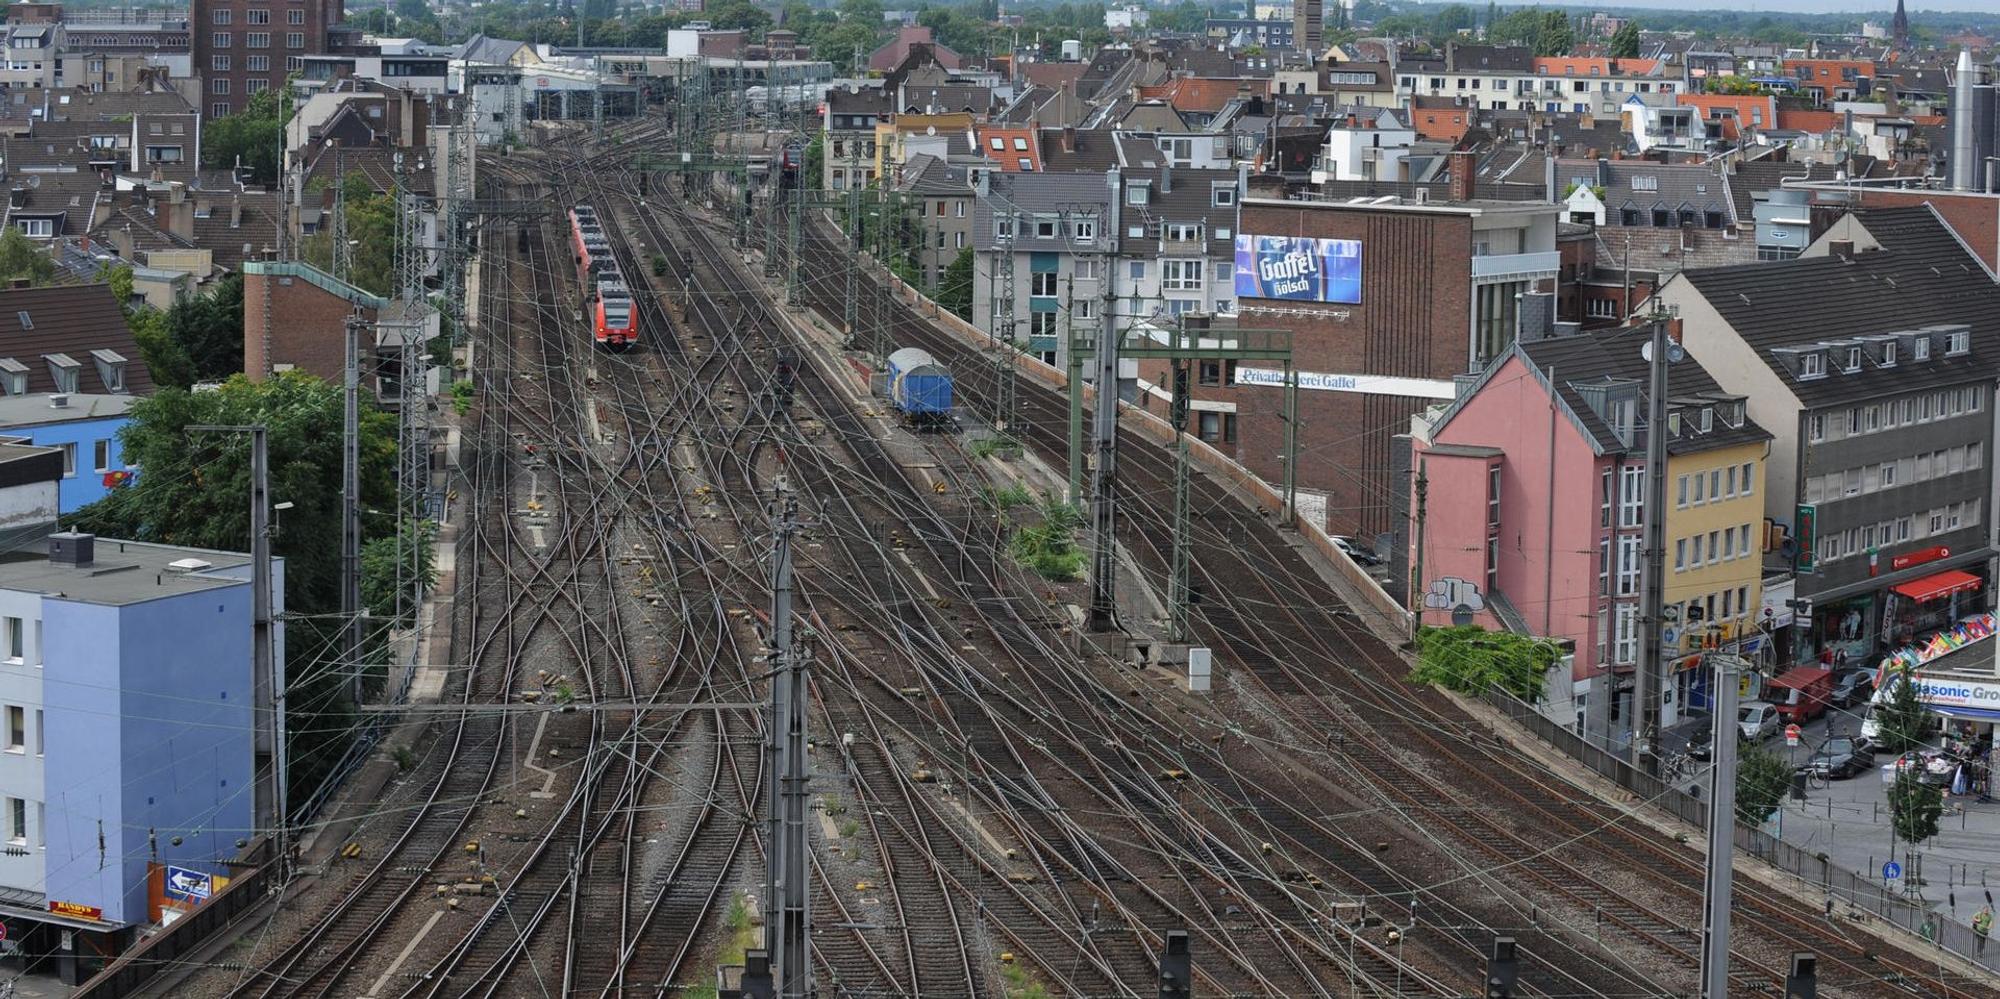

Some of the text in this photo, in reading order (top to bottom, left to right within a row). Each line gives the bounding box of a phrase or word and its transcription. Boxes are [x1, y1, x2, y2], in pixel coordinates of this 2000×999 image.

[1260, 249, 1317, 281] Gaffel
[1241, 369, 1356, 389] Privatberei Gaffel
[1972, 686, 2000, 701] Gro
